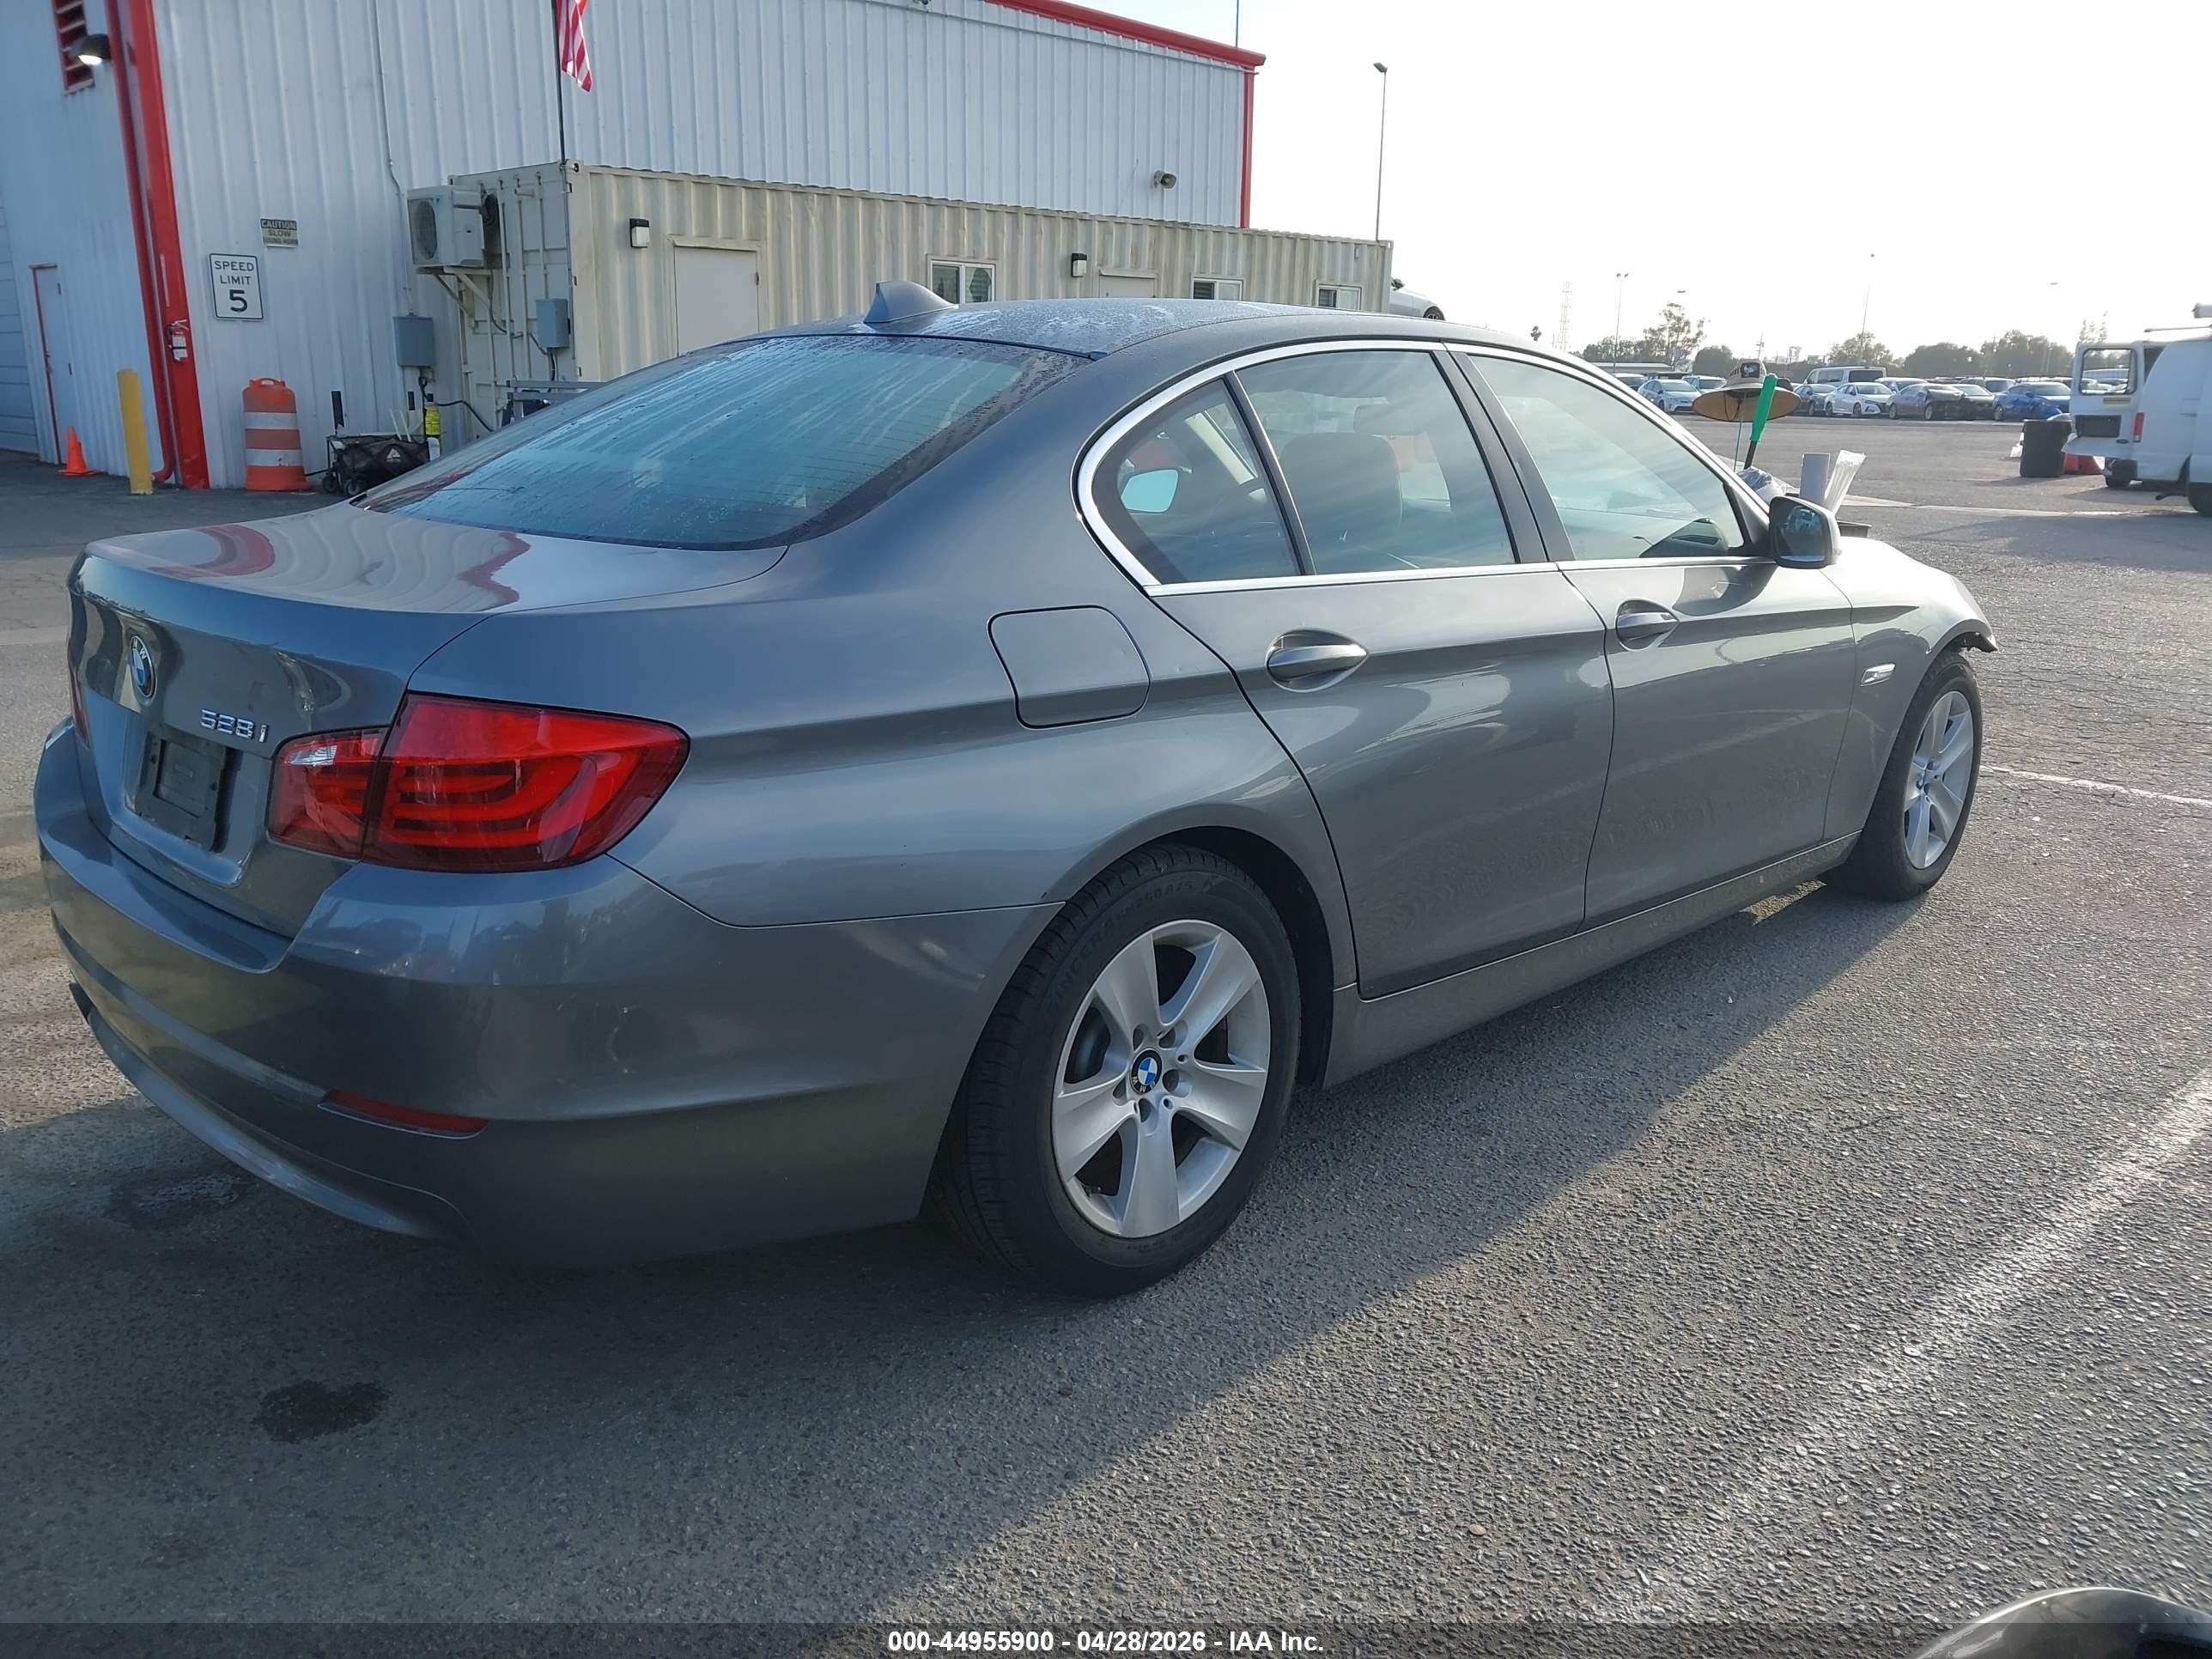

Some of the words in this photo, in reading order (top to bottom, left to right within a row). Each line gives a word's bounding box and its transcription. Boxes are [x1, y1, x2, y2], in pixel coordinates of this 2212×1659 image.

[261, 220, 296, 229] CAUTION
[215, 260, 254, 271] SPEED
[220, 275, 252, 285] LIMIT
[229, 289, 247, 313] 5
[200, 708, 268, 743] 528i
